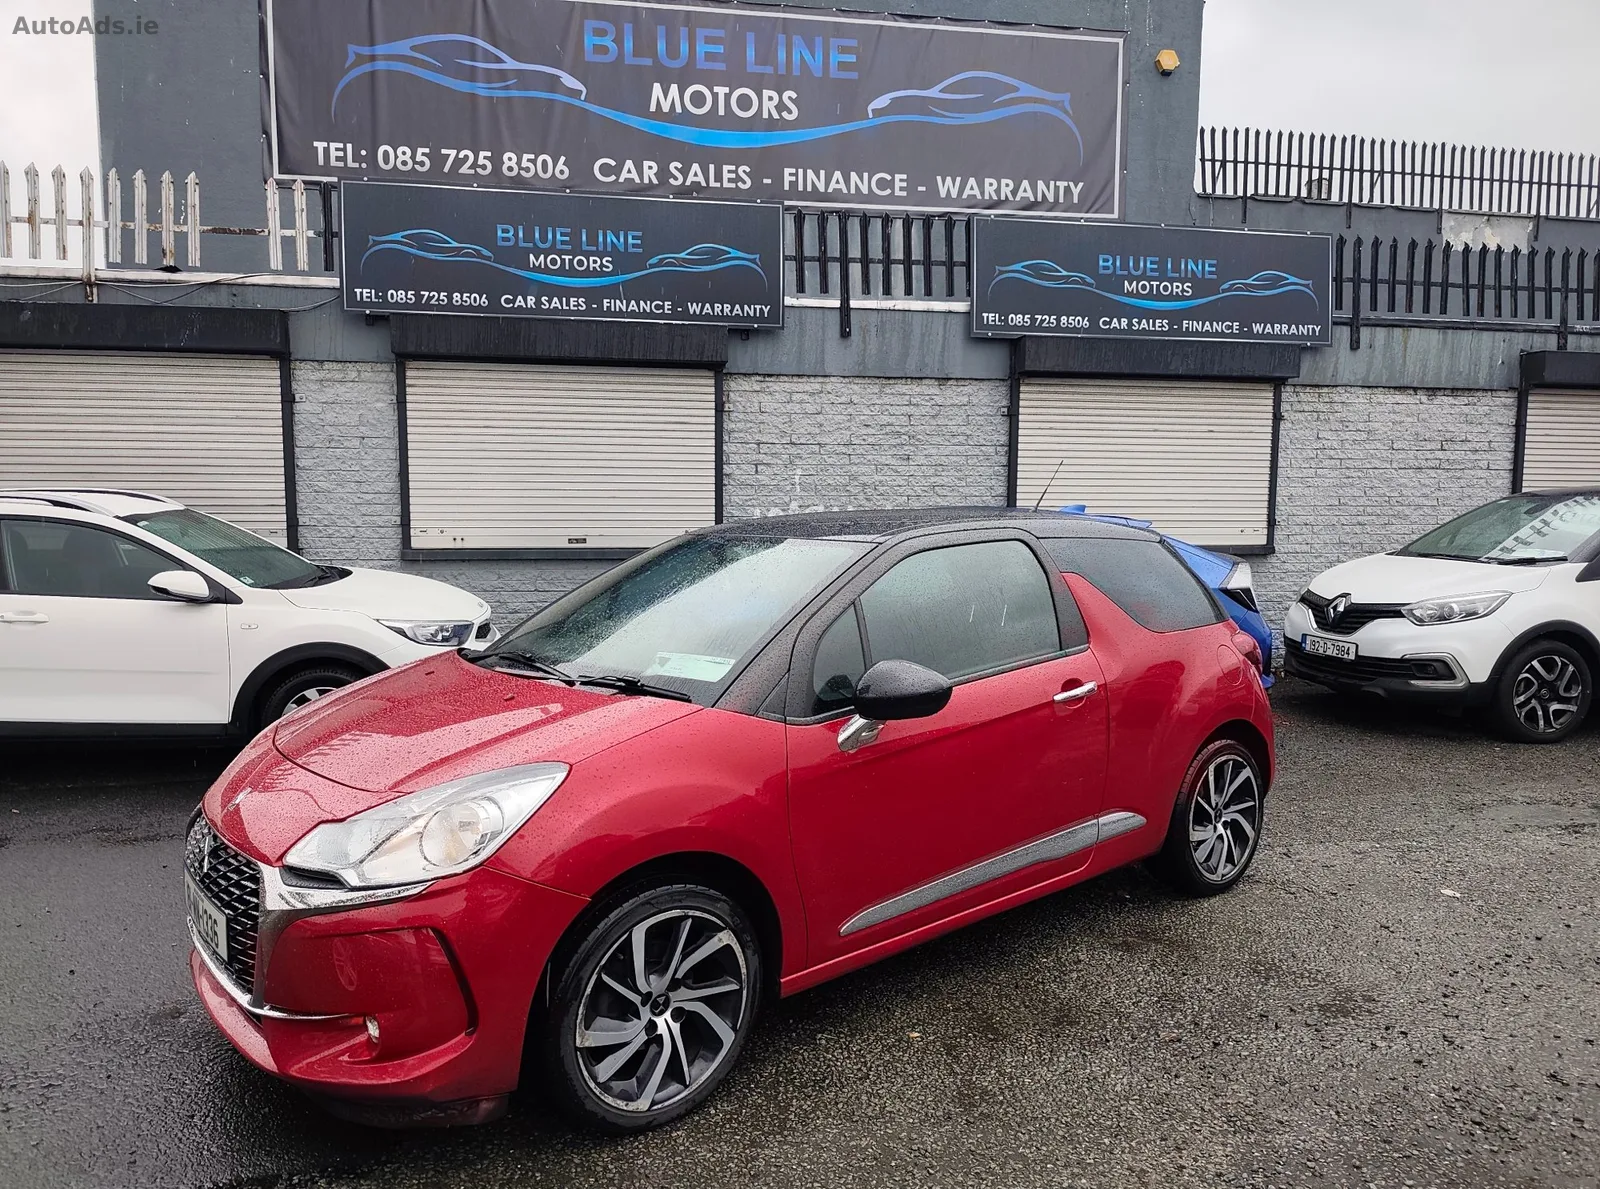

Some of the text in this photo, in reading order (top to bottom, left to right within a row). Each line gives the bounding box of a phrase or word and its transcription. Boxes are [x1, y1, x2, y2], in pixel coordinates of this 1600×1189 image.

[584, 19, 859, 79] BLUE LINE
[649, 82, 799, 121] MOTORS
[313, 141, 368, 169] TEL:
[377, 145, 431, 172] 085
[440, 149, 492, 176] 725
[502, 154, 570, 180] 8506
[593, 157, 659, 186] CAR
[668, 161, 752, 190] SALES
[783, 167, 908, 196] FINANCE
[936, 176, 1084, 203] WARRANTY
[496, 224, 643, 253] BLUE LINE
[529, 253, 614, 272] MOTORS
[1098, 254, 1218, 280] BLUE LINE
[1123, 280, 1193, 297] MOTORS
[354, 288, 383, 303] TEL:
[387, 289, 416, 304] 085
[420, 291, 448, 305] 725
[452, 292, 489, 307] 8506
[500, 294, 536, 309] CAR
[540, 296, 587, 311] SALES
[603, 299, 672, 314] FINANCE
[687, 302, 771, 318] WARRANTY
[982, 312, 1005, 326] TEL:
[1007, 314, 1032, 327] 085
[1034, 315, 1058, 328] 725
[1060, 316, 1090, 329] 8506
[1099, 317, 1129, 330] CAR
[1131, 319, 1169, 332] SALES
[1182, 321, 1240, 334] FINANCE
[1252, 323, 1323, 337] WARRANTY
[1310, 639, 1350, 657] 192-D-7984
